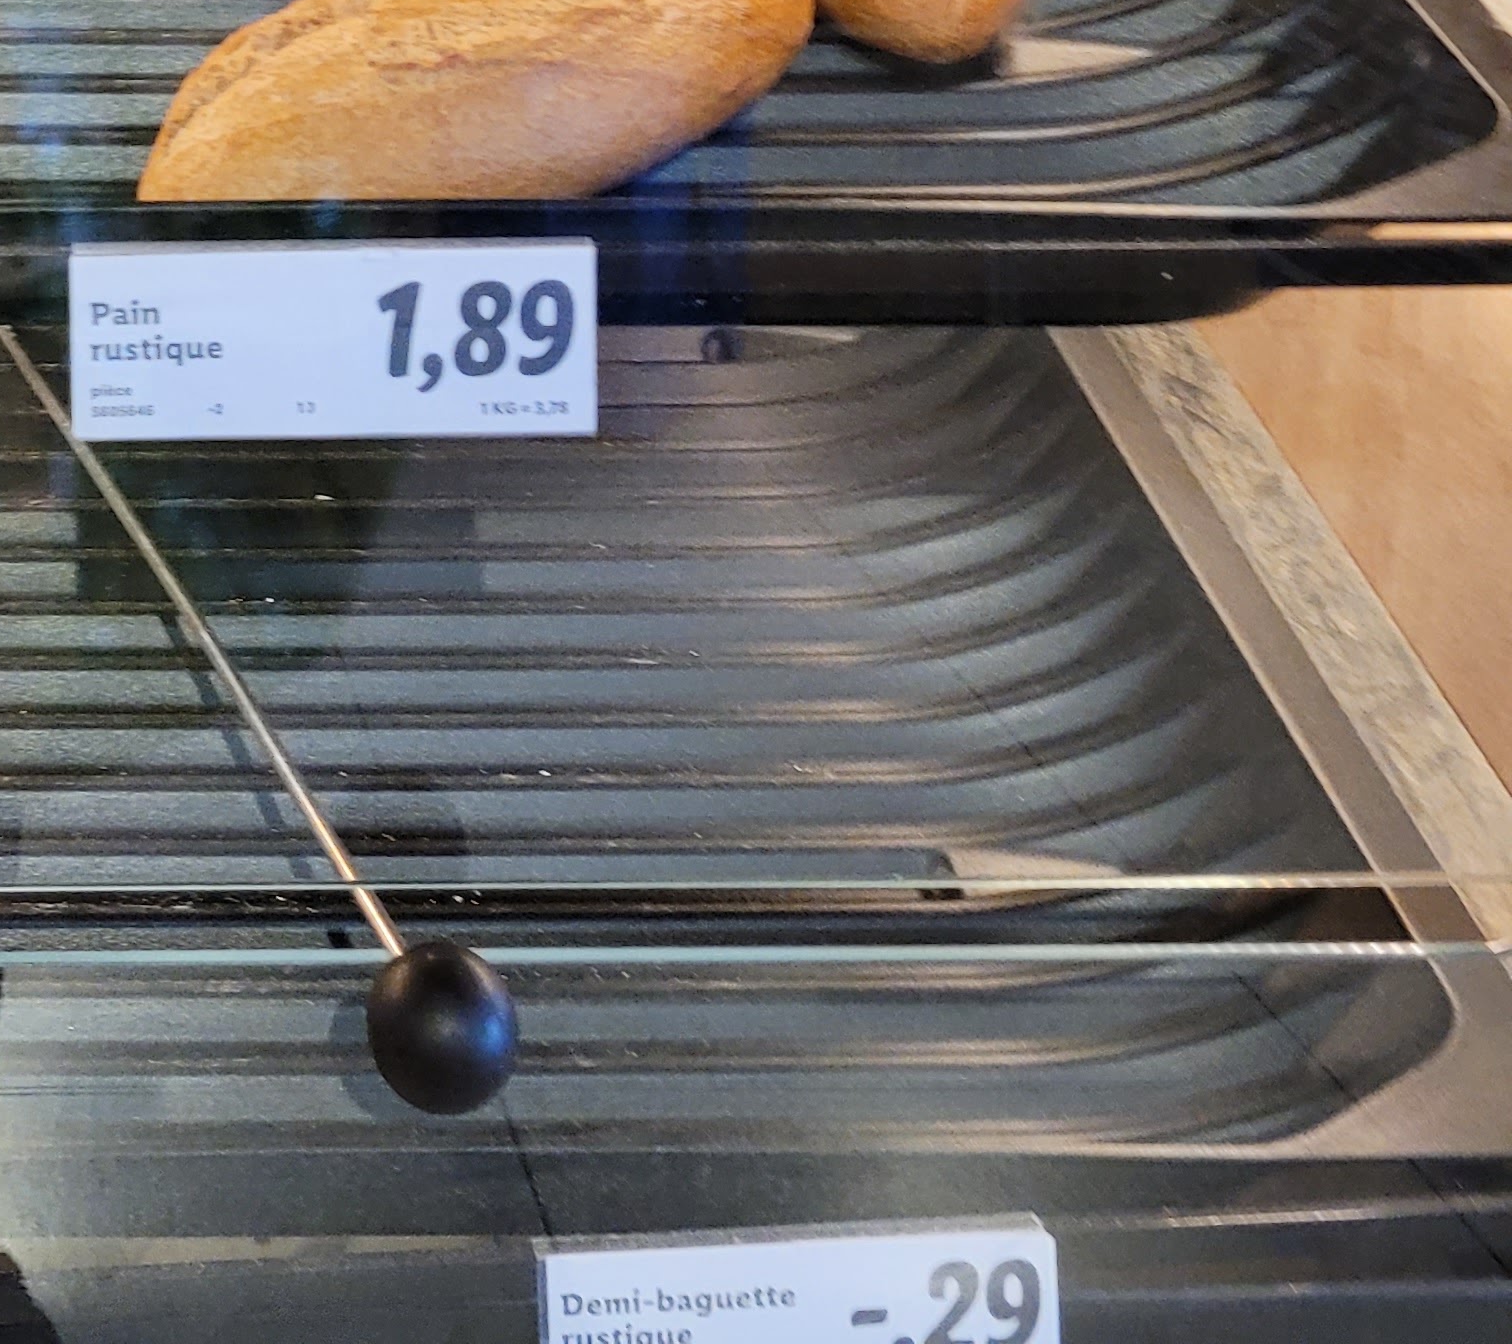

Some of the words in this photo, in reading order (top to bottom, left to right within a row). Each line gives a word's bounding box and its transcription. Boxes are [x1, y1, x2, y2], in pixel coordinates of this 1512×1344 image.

[90, 299, 160, 325] Pain
[90, 334, 224, 366] rustique
[378, 280, 575, 392] 1,89
[561, 1287, 797, 1318] Demi-baguette
